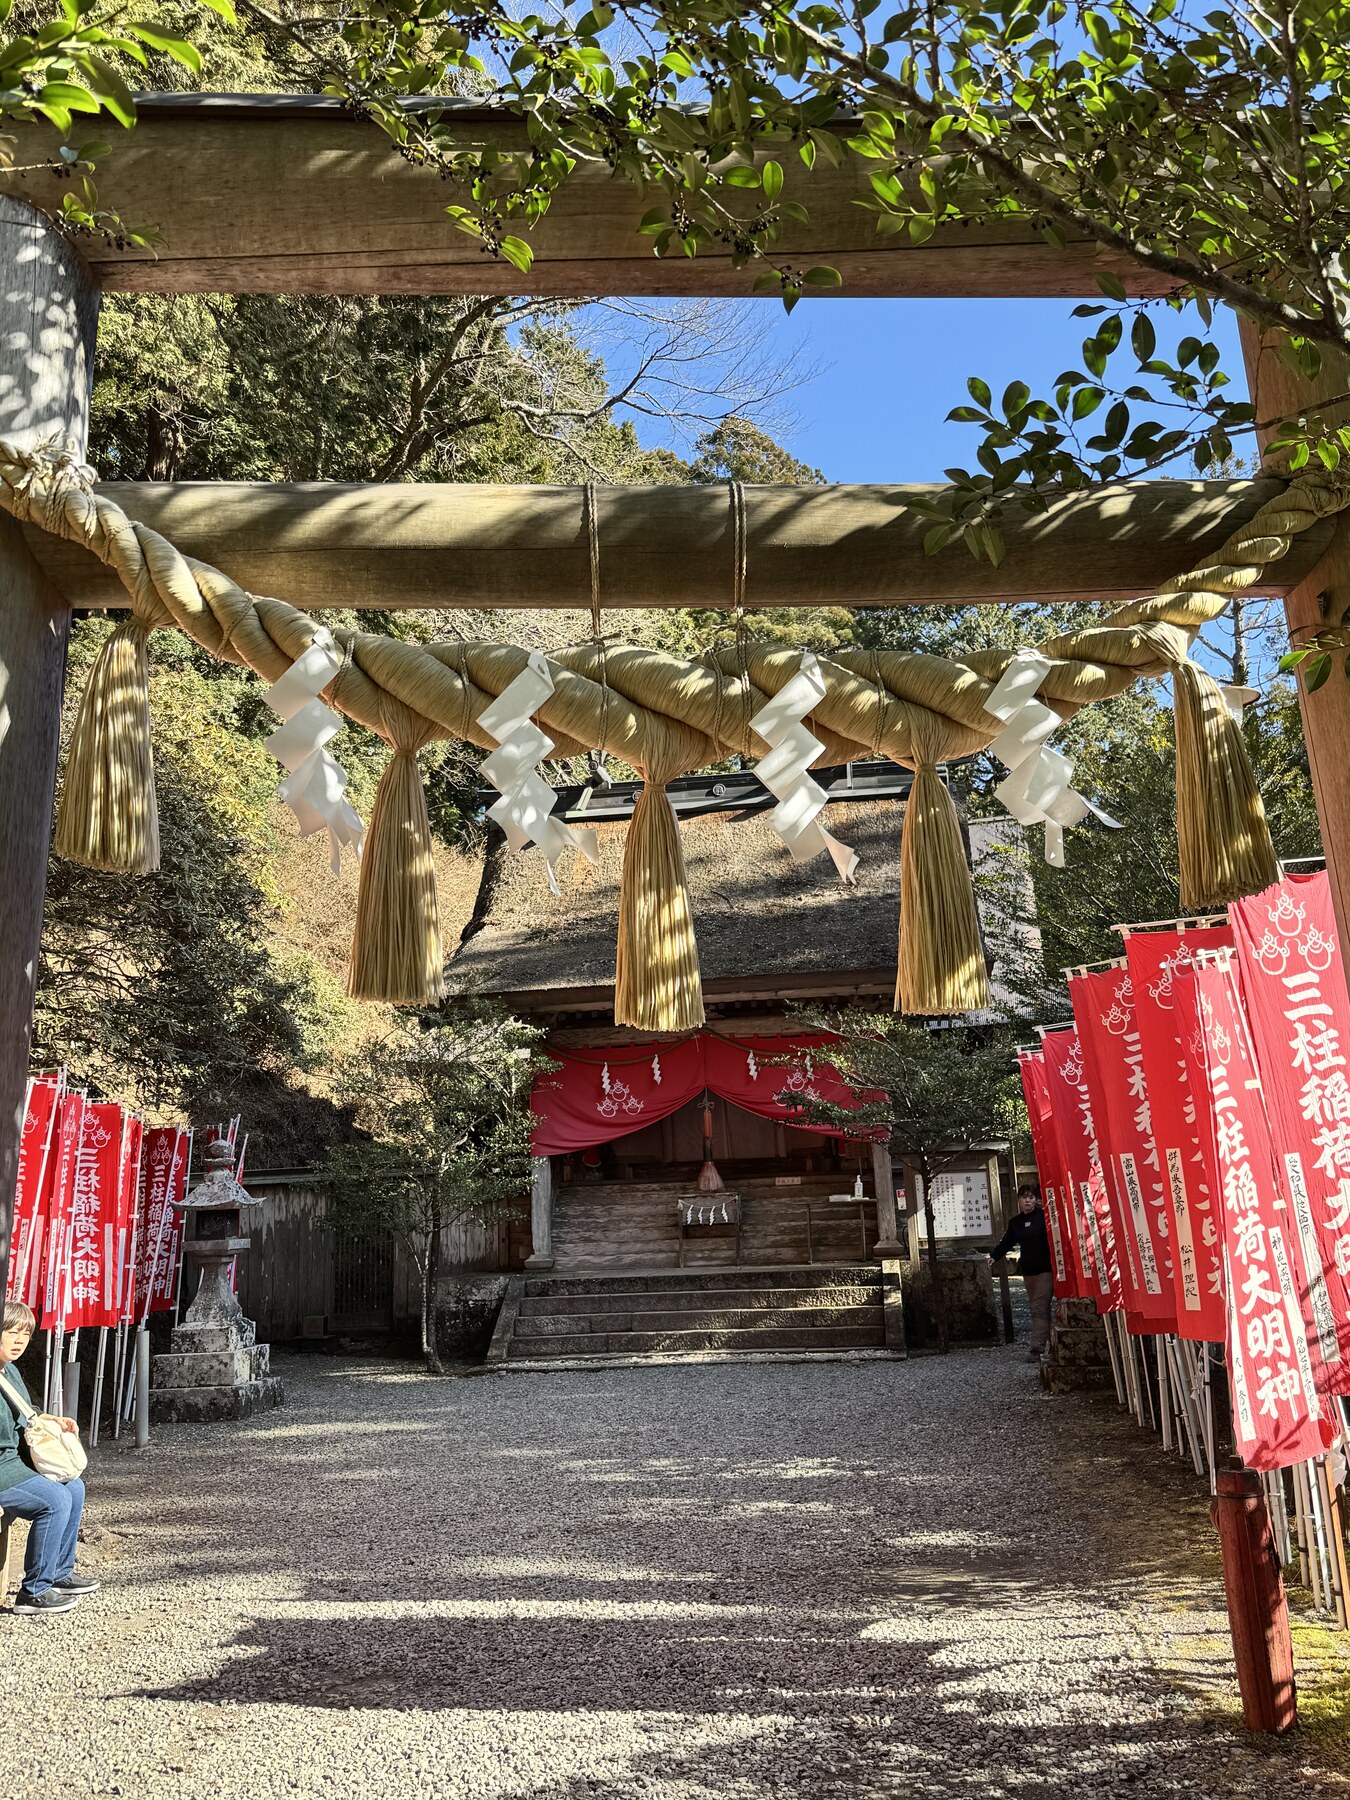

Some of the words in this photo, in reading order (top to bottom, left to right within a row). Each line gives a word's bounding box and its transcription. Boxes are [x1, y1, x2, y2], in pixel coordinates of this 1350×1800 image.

[1210, 1065, 1300, 1422] 三柱稲荷大明神
